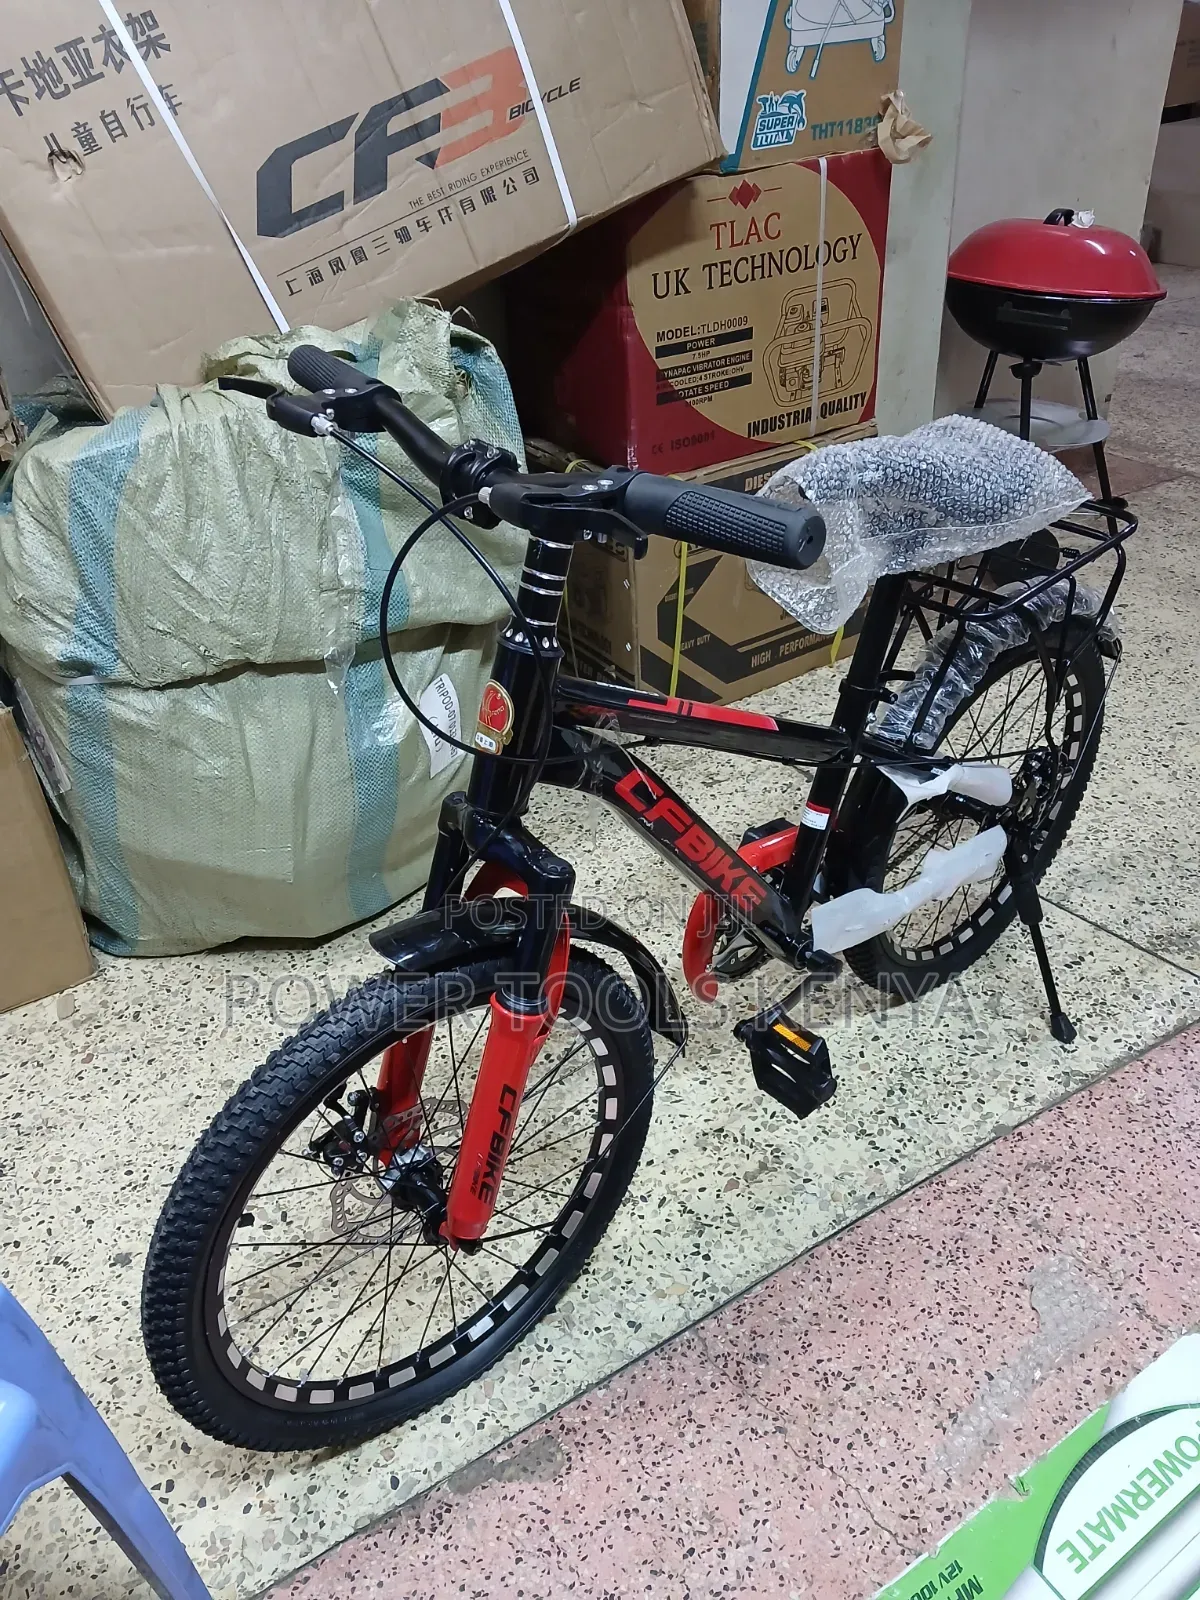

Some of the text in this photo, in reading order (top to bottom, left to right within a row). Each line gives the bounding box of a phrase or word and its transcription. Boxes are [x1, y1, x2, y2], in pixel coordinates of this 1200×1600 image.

[0, 10, 171, 117] 卡地亚衣架
[758, 117, 795, 132] SUPER
[408, 149, 528, 210] THE BEST RIDING EXPERIENCE
[709, 212, 782, 251] TLAC
[651, 233, 863, 300] UK TECHNOLOGY
[656, 315, 748, 343] MODEL:TLDH0009
[686, 337, 716, 351] POWER
[692, 358, 726, 372] VIBRATOR
[726, 352, 750, 365] ENGINE
[704, 380, 730, 393] SPEED
[820, 391, 868, 420] QUALITY
[697, 634, 711, 646] DUTY
[751, 649, 772, 668] HIGH
[615, 770, 767, 912] CFBIKE
[477, 1083, 518, 1205] CFBIKE
[1055, 1418, 1200, 1575] OWERMATE
[938, 1559, 963, 1589] 12V
